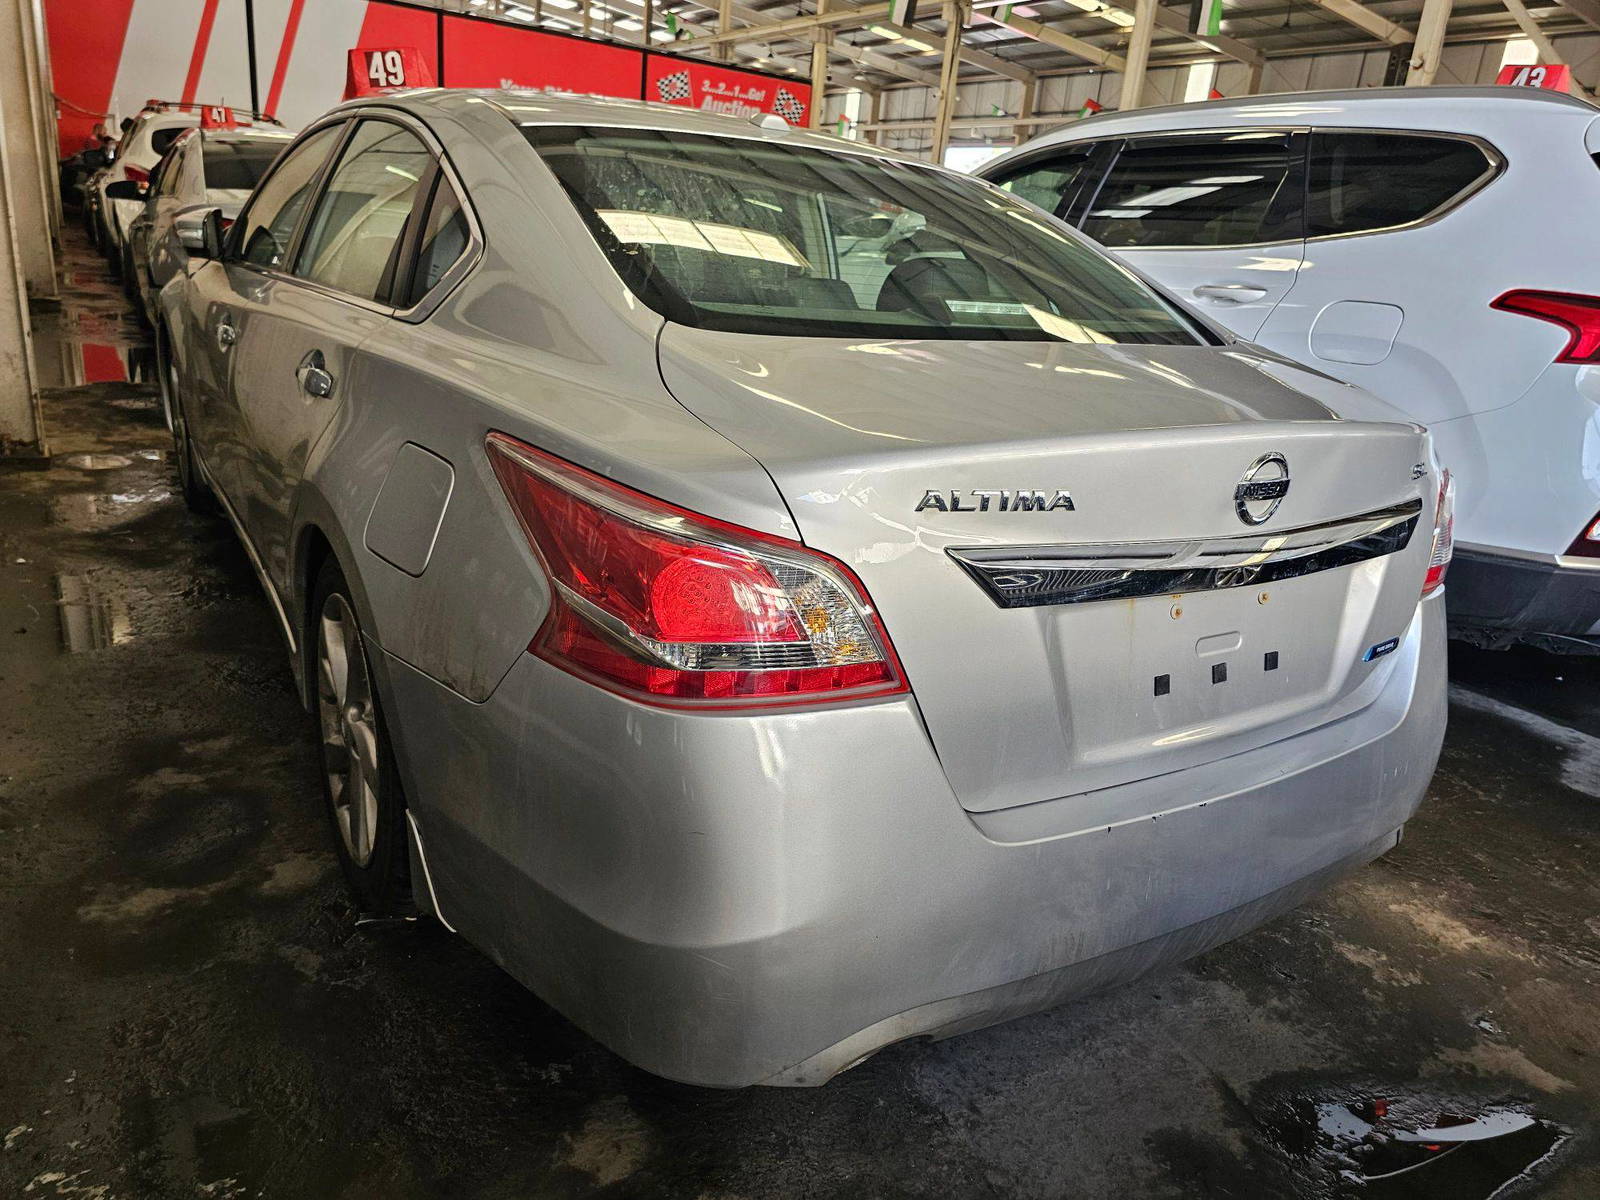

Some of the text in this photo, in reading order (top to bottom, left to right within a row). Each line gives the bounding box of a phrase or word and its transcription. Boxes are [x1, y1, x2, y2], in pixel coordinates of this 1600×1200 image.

[369, 50, 405, 87] 49
[914, 489, 1076, 512] ALTIMA
[1242, 481, 1287, 498] NISSA
